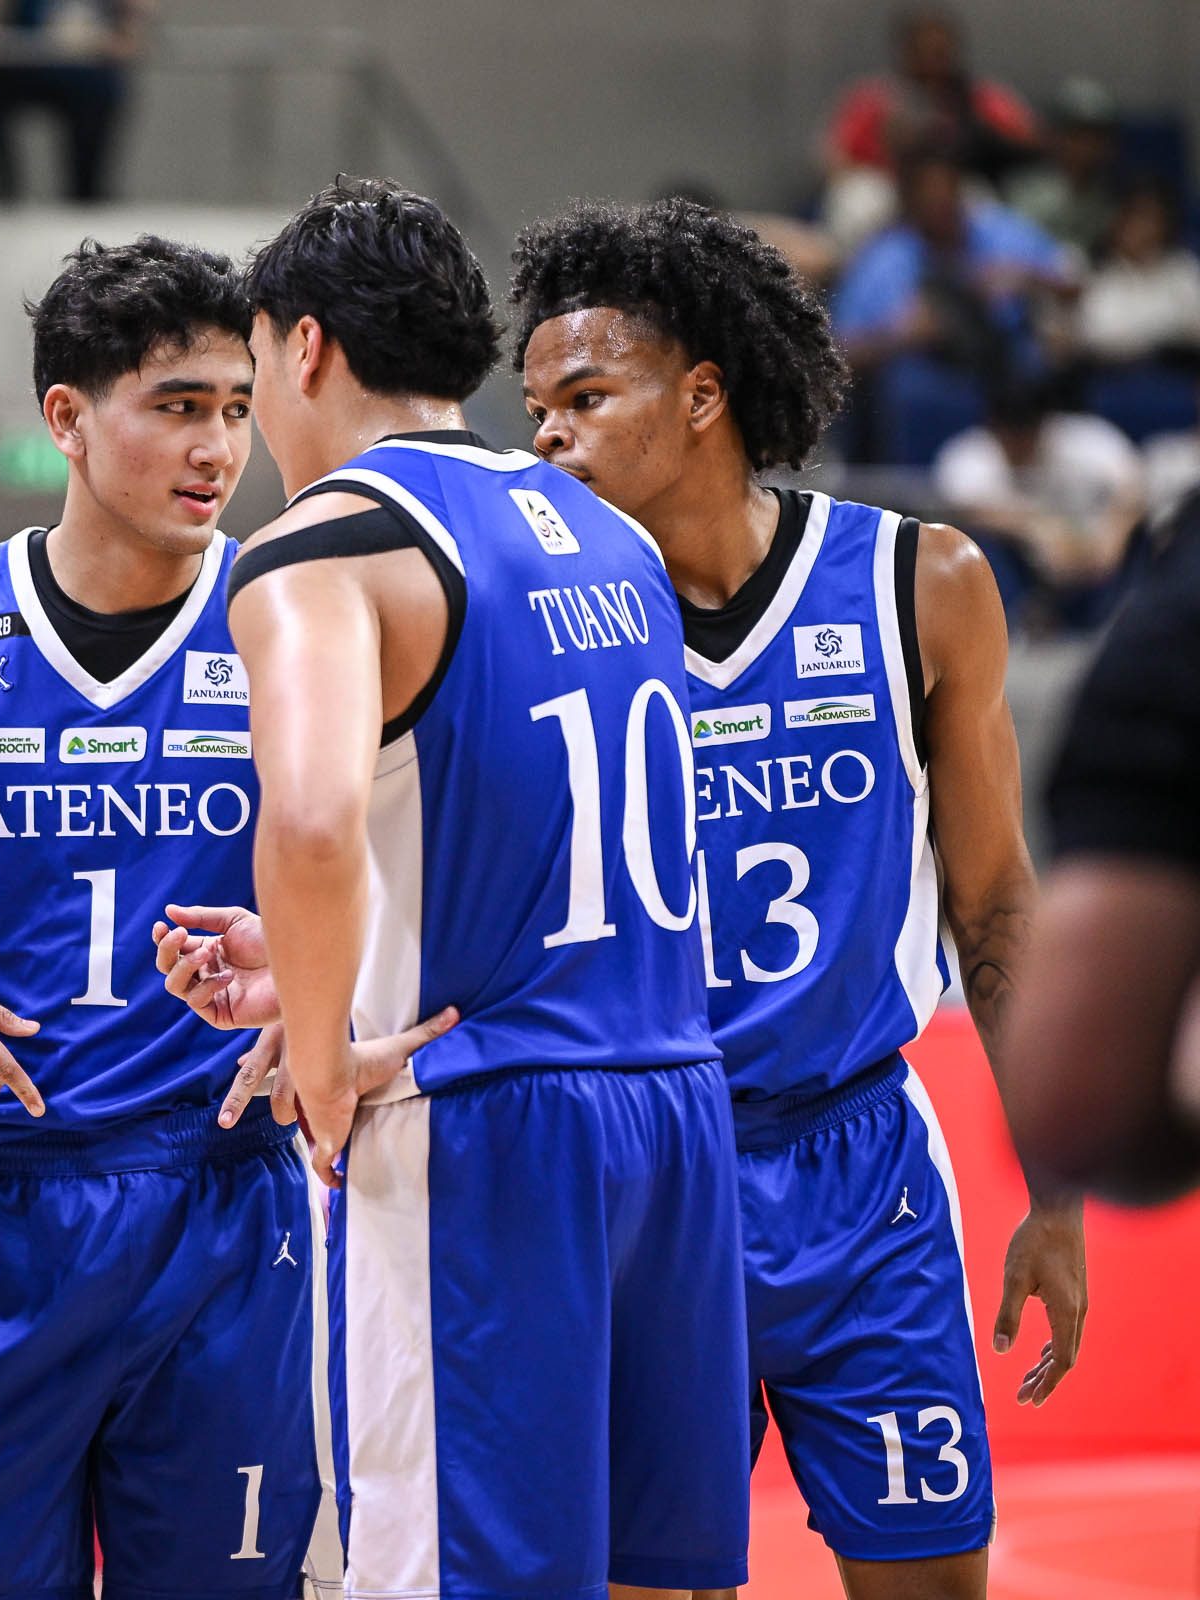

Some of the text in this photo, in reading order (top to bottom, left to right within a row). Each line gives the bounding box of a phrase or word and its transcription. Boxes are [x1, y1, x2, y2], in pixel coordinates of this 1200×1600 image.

[527, 579, 650, 656] TUANO
[187, 689, 248, 700] JANUARIUS
[800, 659, 861, 674] JANUARIUS
[88, 737, 138, 753] Smart
[713, 715, 764, 736] Smart
[529, 678, 697, 950] 10
[696, 750, 876, 820] ENEO
[70, 868, 128, 1007] 1
[866, 1405, 969, 1505] 13
[230, 1464, 266, 1560] 1
